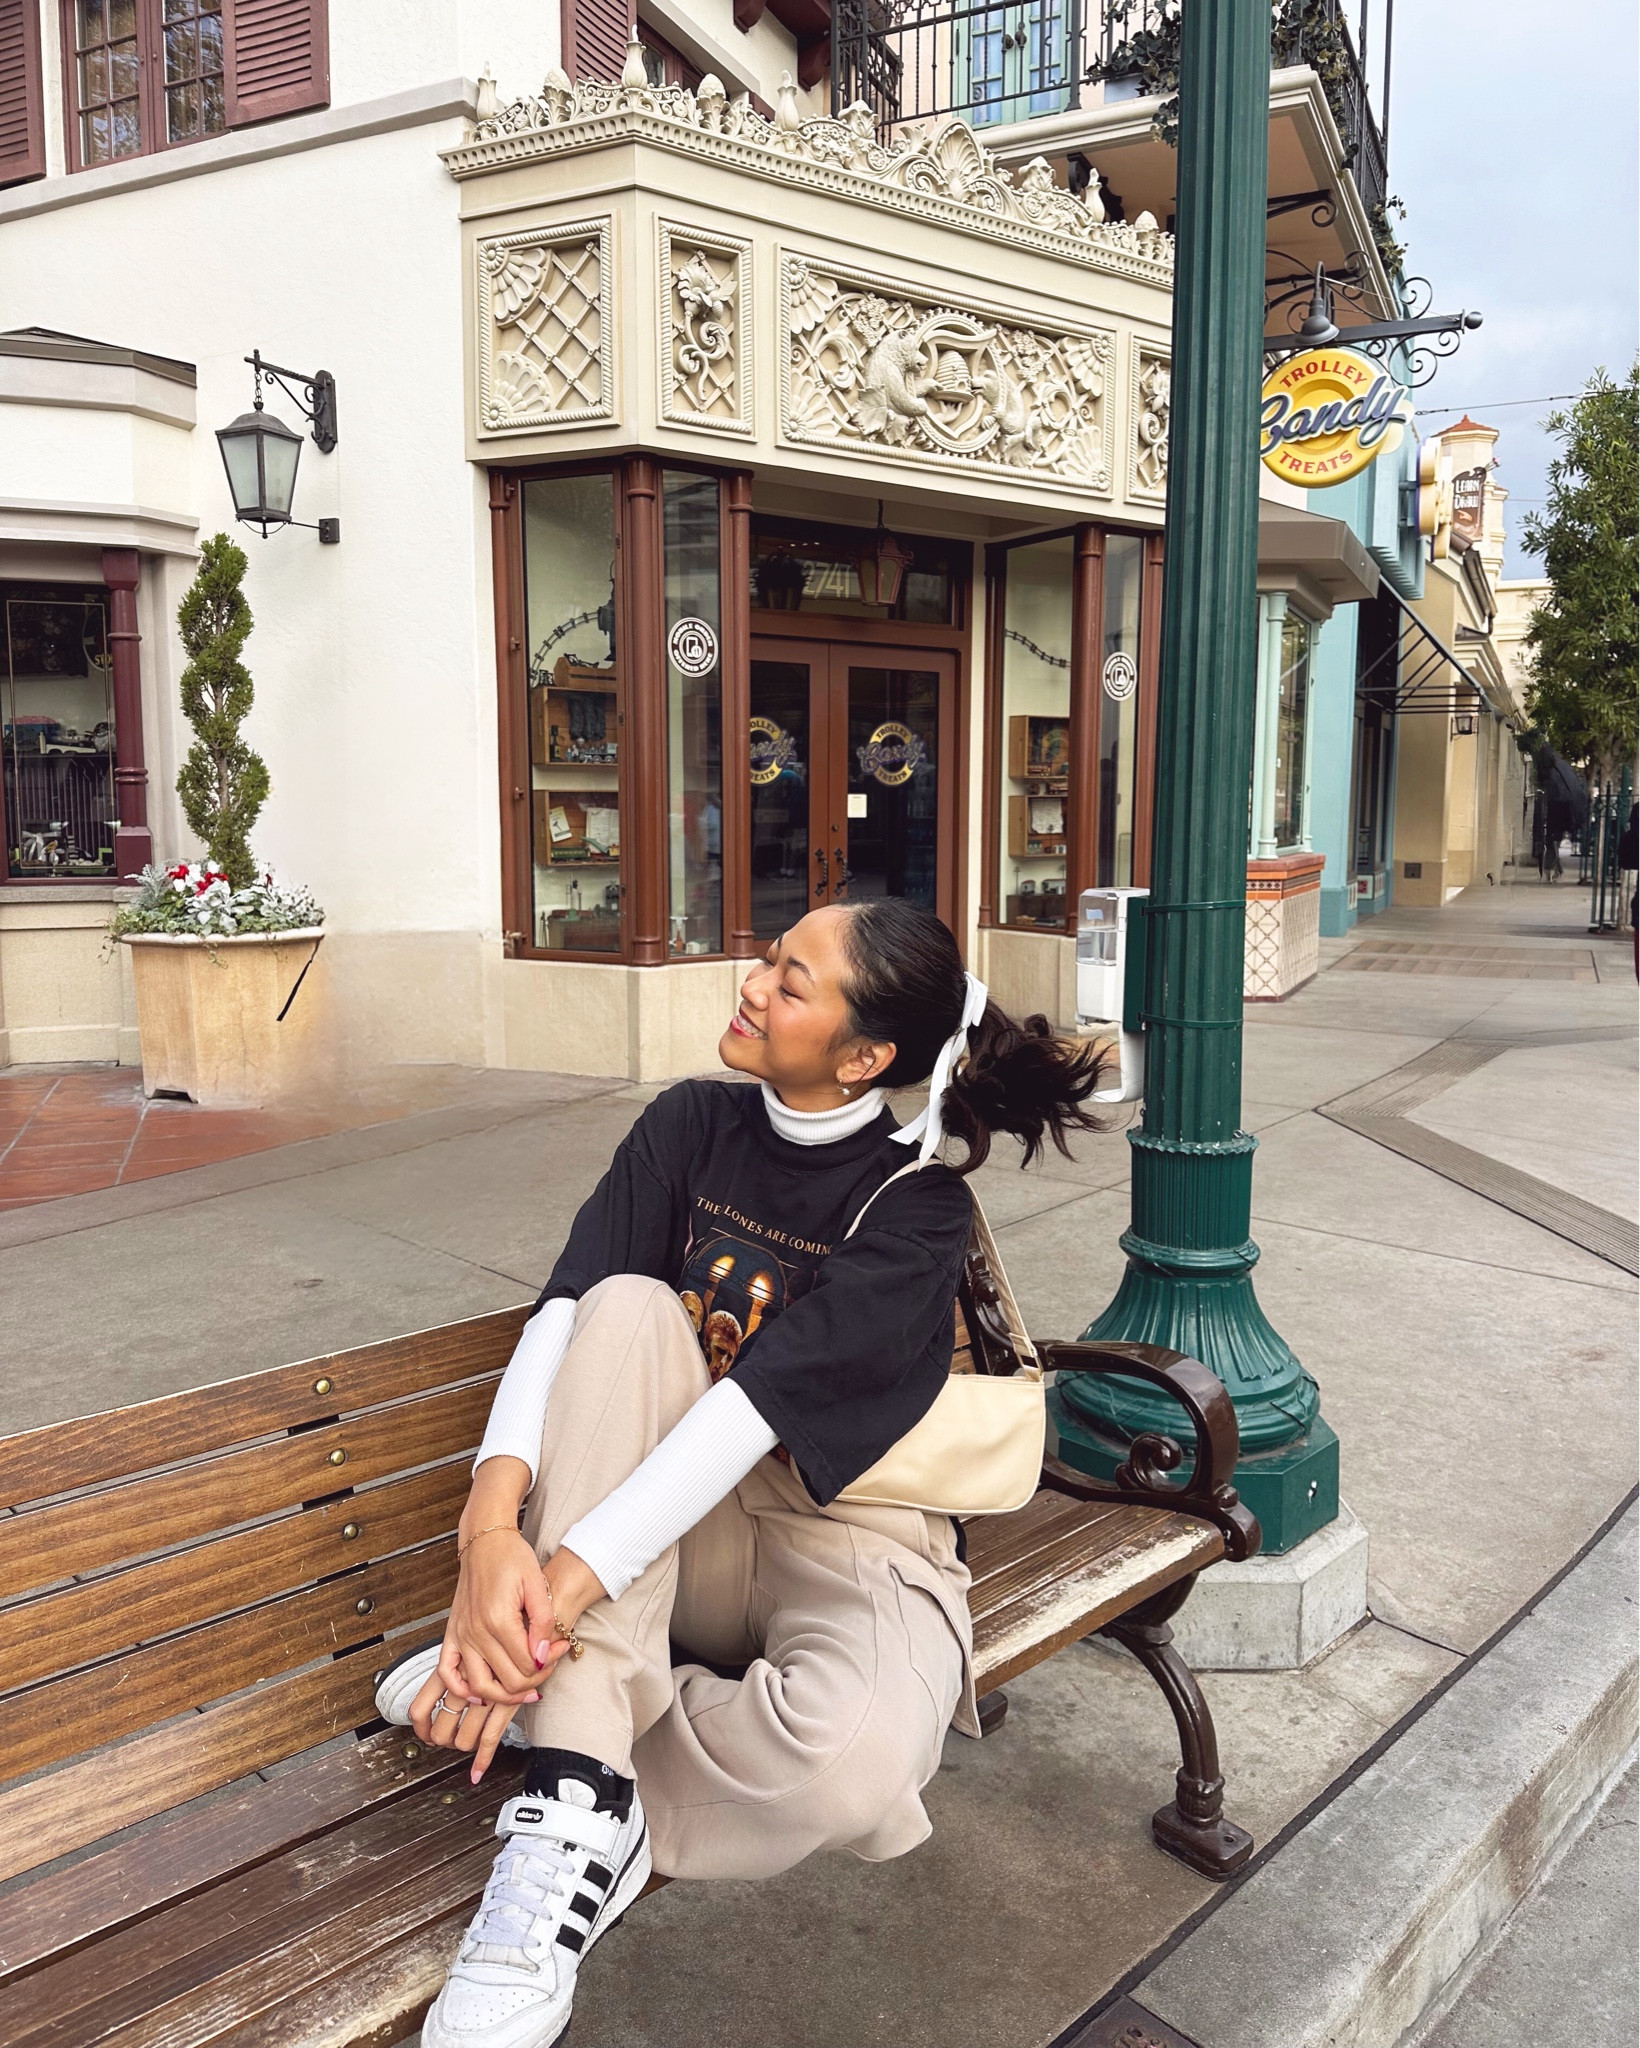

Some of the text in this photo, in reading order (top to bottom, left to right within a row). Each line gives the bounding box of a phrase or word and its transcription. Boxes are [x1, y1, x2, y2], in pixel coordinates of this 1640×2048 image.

[1279, 360, 1368, 389] TROLLEY
[1278, 450, 1354, 475] TREATS
[1455, 479, 1480, 494] LEARN
[751, 720, 778, 735] OLLEY
[876, 724, 908, 739] TROLLEY
[878, 770, 907, 783] TREATS
[697, 1196, 722, 1216] THE
[723, 1205, 764, 1235] LONES
[764, 1228, 788, 1244] ARE
